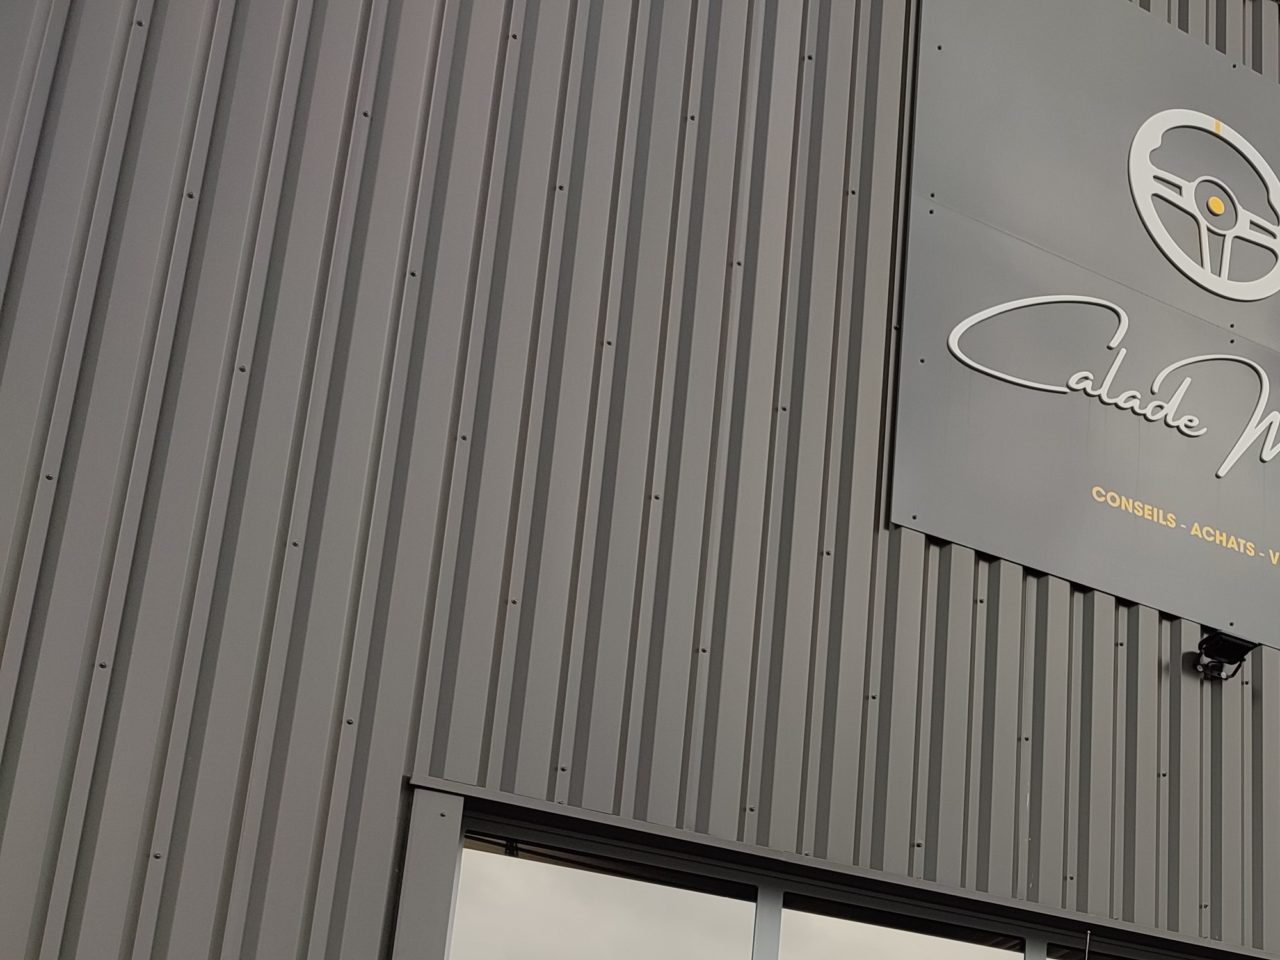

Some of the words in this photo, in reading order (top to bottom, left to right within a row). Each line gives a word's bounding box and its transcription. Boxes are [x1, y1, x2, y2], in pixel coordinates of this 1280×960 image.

[947, 294, 1207, 438] Calade
[1091, 484, 1177, 529] CONSEILS
[1190, 521, 1256, 557] ACHATS
